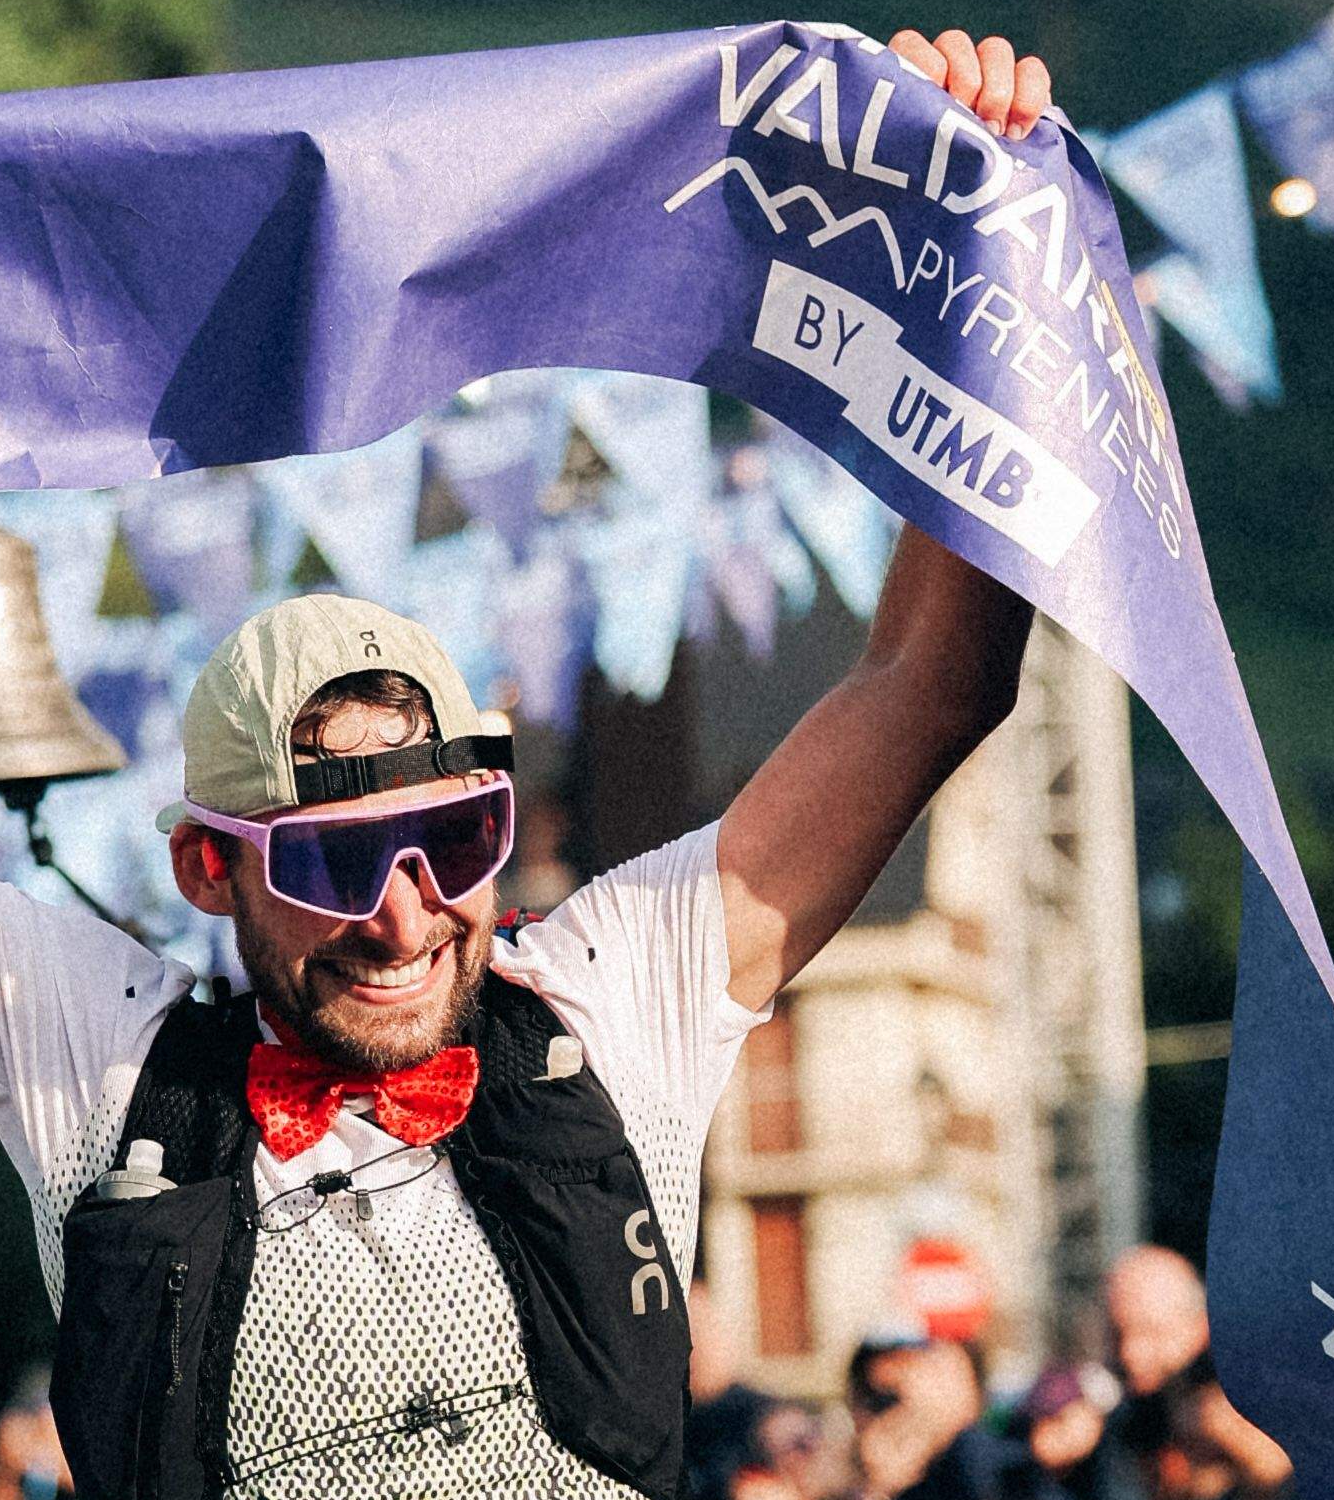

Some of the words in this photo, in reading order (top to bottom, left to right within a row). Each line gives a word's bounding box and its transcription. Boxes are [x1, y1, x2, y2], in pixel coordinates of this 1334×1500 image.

[794, 293, 865, 368] BY
[887, 375, 1034, 510] UTMB
[906, 238, 1184, 561] PYRENEES
